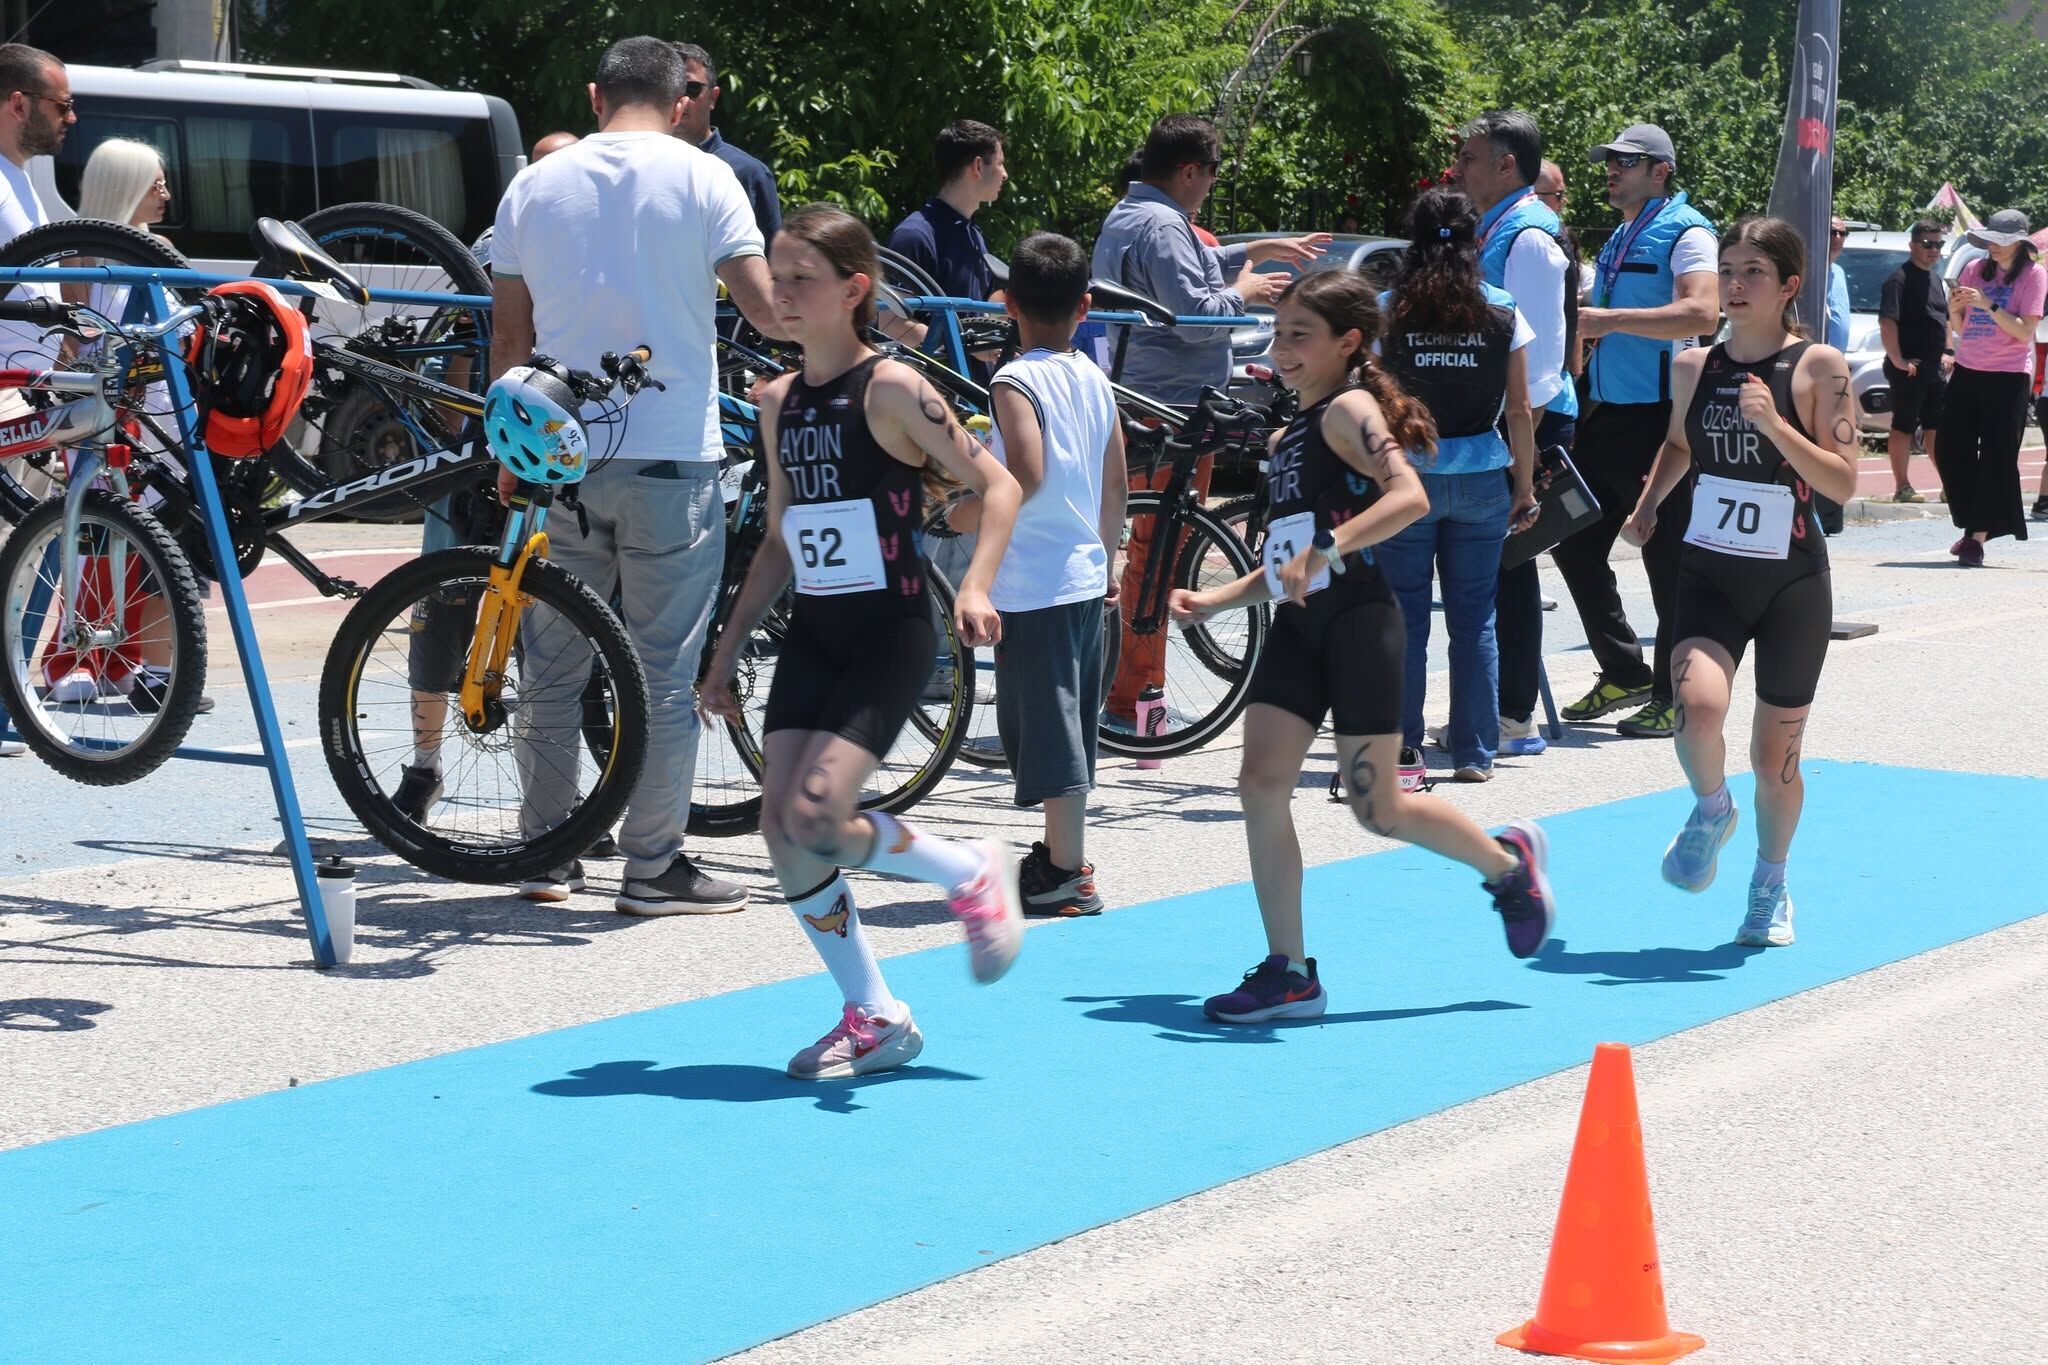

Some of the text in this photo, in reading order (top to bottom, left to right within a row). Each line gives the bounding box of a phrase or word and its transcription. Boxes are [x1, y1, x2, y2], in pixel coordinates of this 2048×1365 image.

[1405, 332, 1486, 347] TECHNICAL
[1415, 353, 1478, 367] OFFICIAL
[1832, 376, 1854, 445] 70
[567, 429, 582, 447] 26
[780, 424, 842, 463] AYDIN
[1706, 432, 1762, 464] TUR
[288, 441, 474, 519] KRON
[785, 464, 842, 499] TUR
[1268, 470, 1303, 503] TUR
[1717, 497, 1760, 534] 70
[799, 527, 846, 568] 62
[1779, 718, 1804, 785] 70
